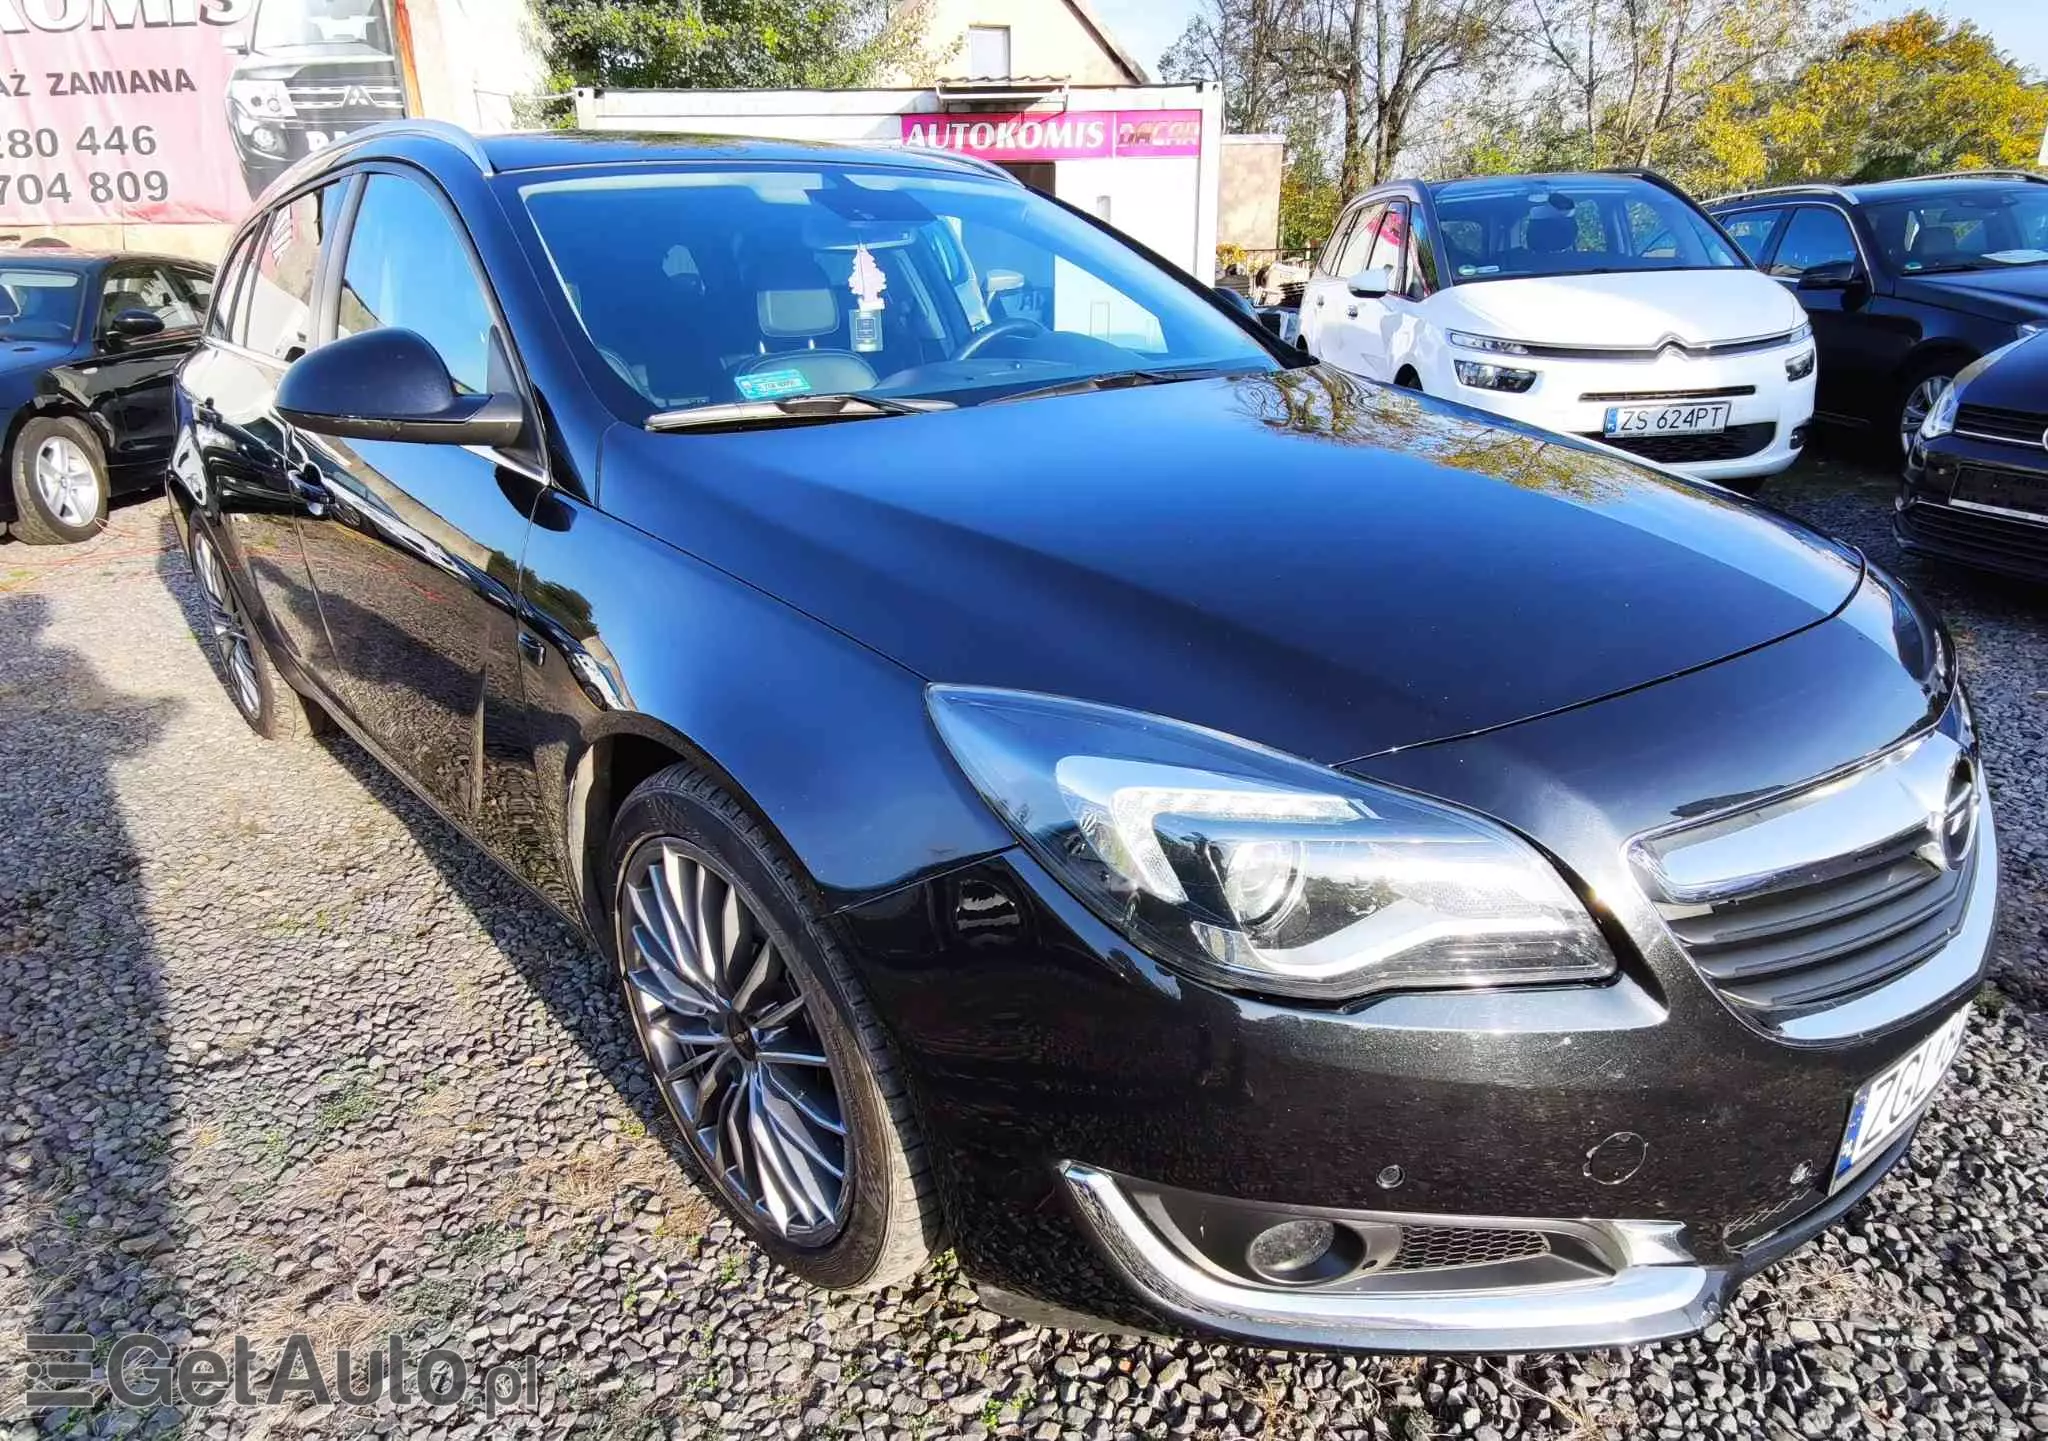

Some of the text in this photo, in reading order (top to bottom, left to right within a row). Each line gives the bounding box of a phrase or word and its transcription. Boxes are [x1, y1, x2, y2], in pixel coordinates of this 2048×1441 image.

[46, 68, 197, 96] ZAMIANA
[0, 125, 157, 159] 80 446
[908, 121, 1104, 150] AUTOKOMIS
[88, 170, 169, 203] 809
[1620, 407, 1723, 431] ZS 624PT
